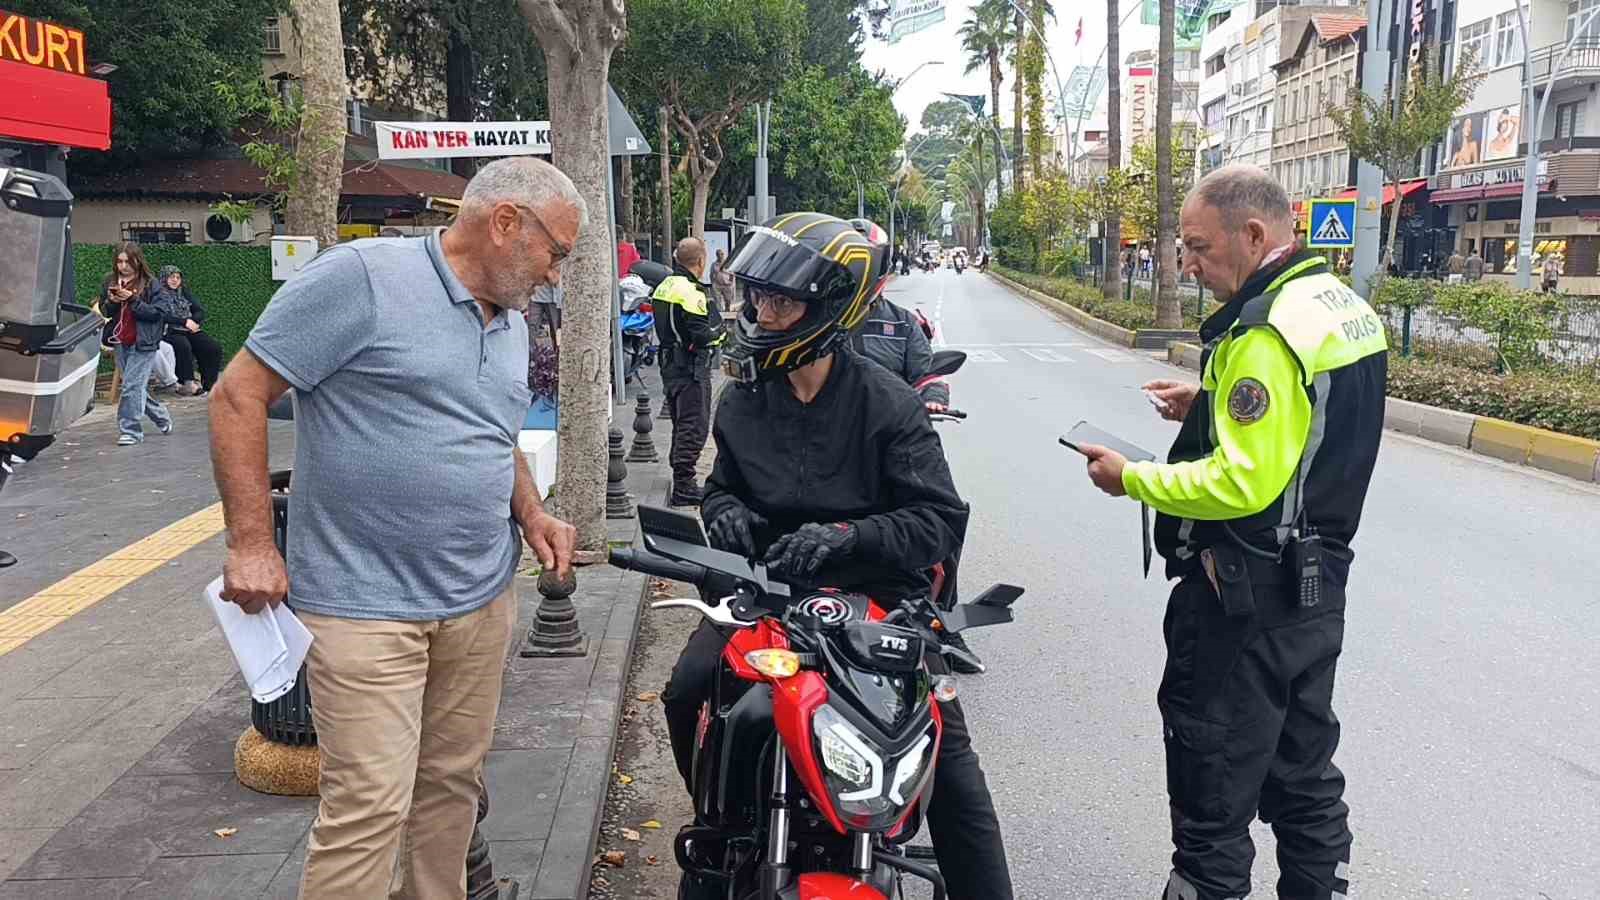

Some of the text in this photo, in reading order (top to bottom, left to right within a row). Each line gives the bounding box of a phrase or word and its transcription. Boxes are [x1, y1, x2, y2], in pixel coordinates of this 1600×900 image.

[392, 131, 428, 149] KAN
[434, 131, 469, 148] VER
[474, 130, 529, 146] HAYAT
[880, 635, 908, 651] TVS
